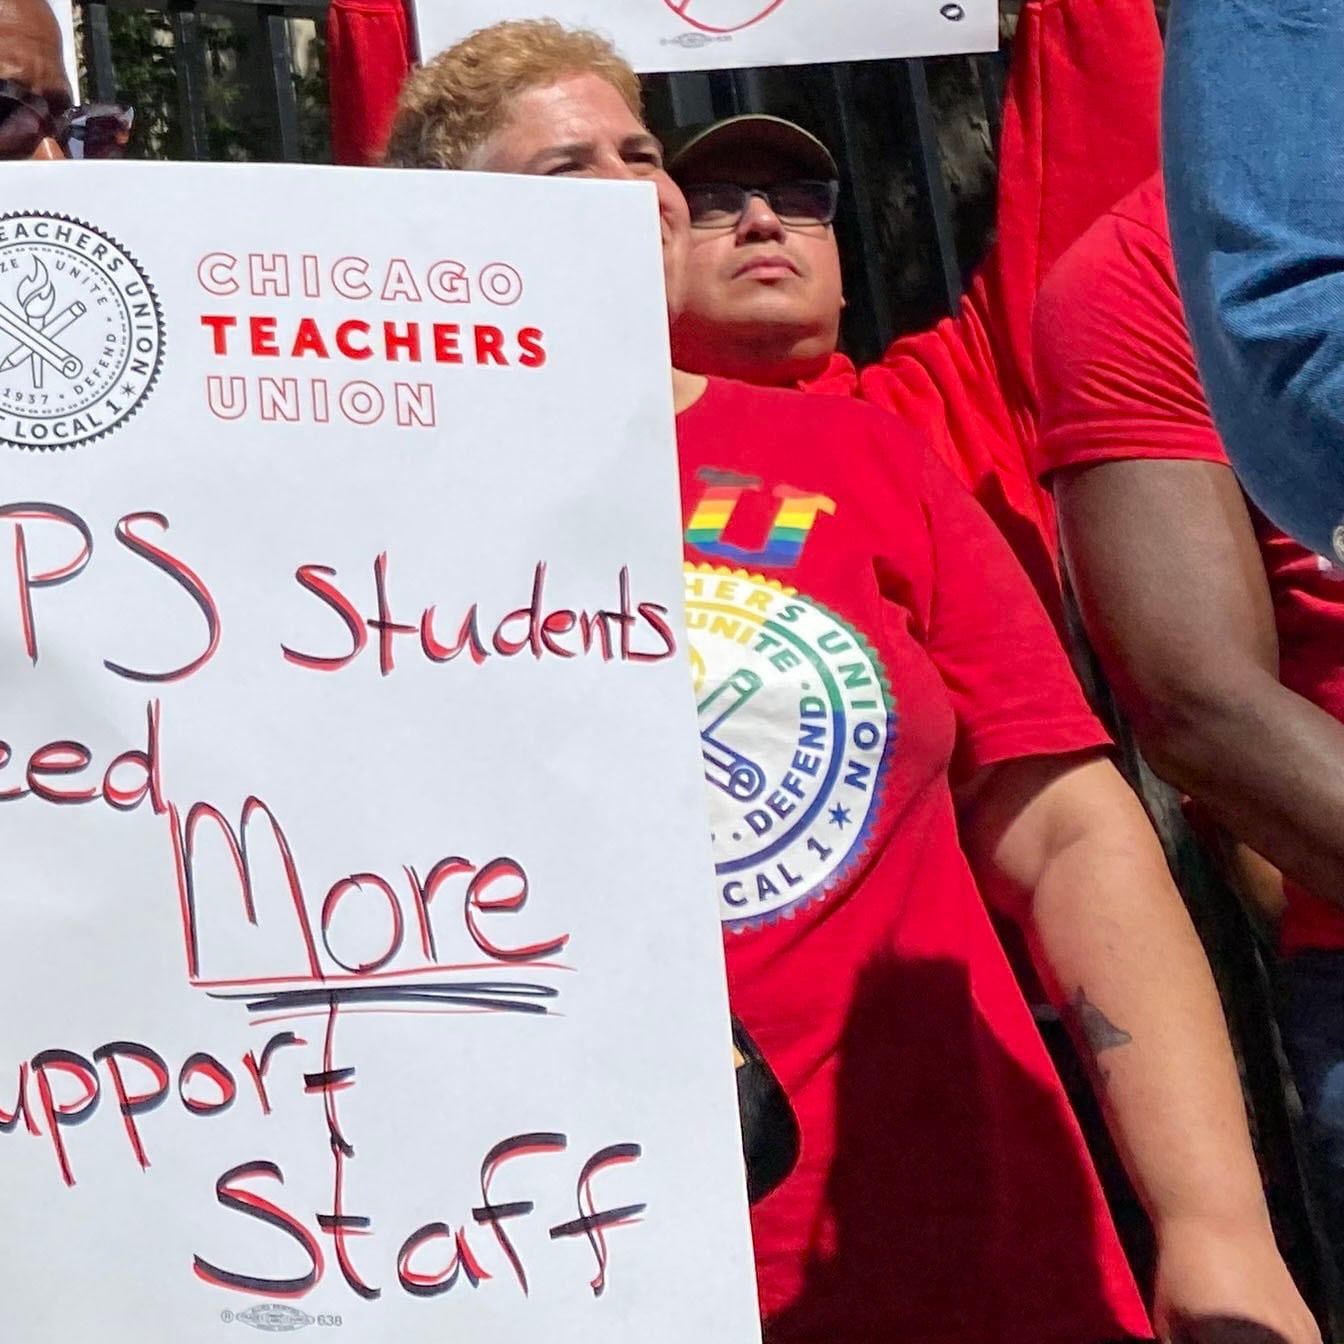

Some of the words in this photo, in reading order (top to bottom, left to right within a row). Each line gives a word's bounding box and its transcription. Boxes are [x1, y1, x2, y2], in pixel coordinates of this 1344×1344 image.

[197, 252, 523, 306] CHICAGO
[124, 280, 153, 375] UNION
[201, 315, 547, 368] TEACHERS
[15, 413, 102, 439] LOCAL
[106, 398, 122, 416] 1
[207, 376, 436, 427] UNION
[819, 629, 880, 792] UNION
[744, 693, 829, 838] DEFEND
[168, 794, 569, 981] More
[193, 1132, 649, 1300] Staff
